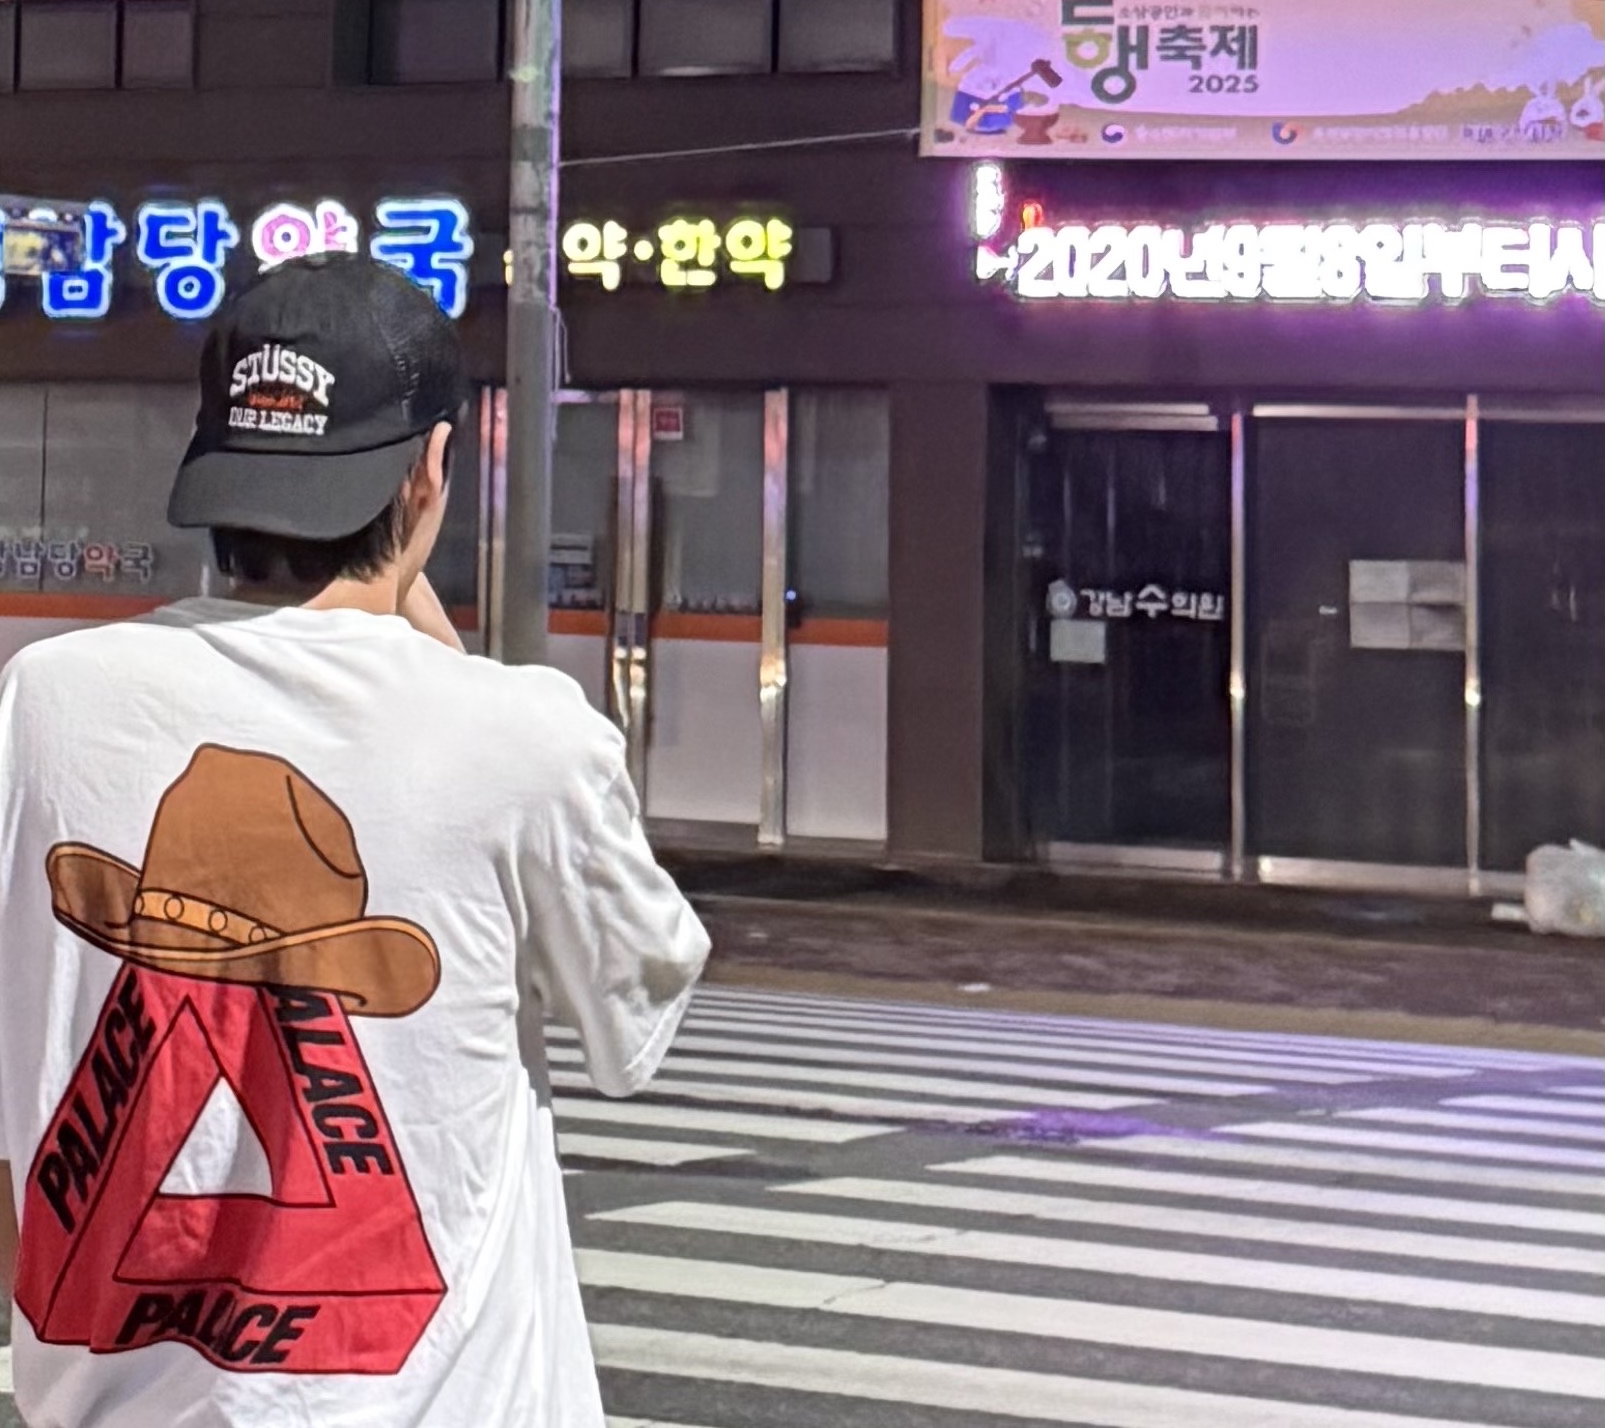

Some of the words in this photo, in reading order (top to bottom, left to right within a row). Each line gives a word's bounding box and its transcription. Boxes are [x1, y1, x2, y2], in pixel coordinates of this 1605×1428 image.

[1188, 75, 1260, 93] 2025
[504, 219, 793, 290] 약·한약
[258, 410, 328, 435] LEGACY
[1080, 583, 1225, 620] 강남수의원
[37, 968, 156, 1235] PALACE
[274, 986, 394, 1176] ALACE
